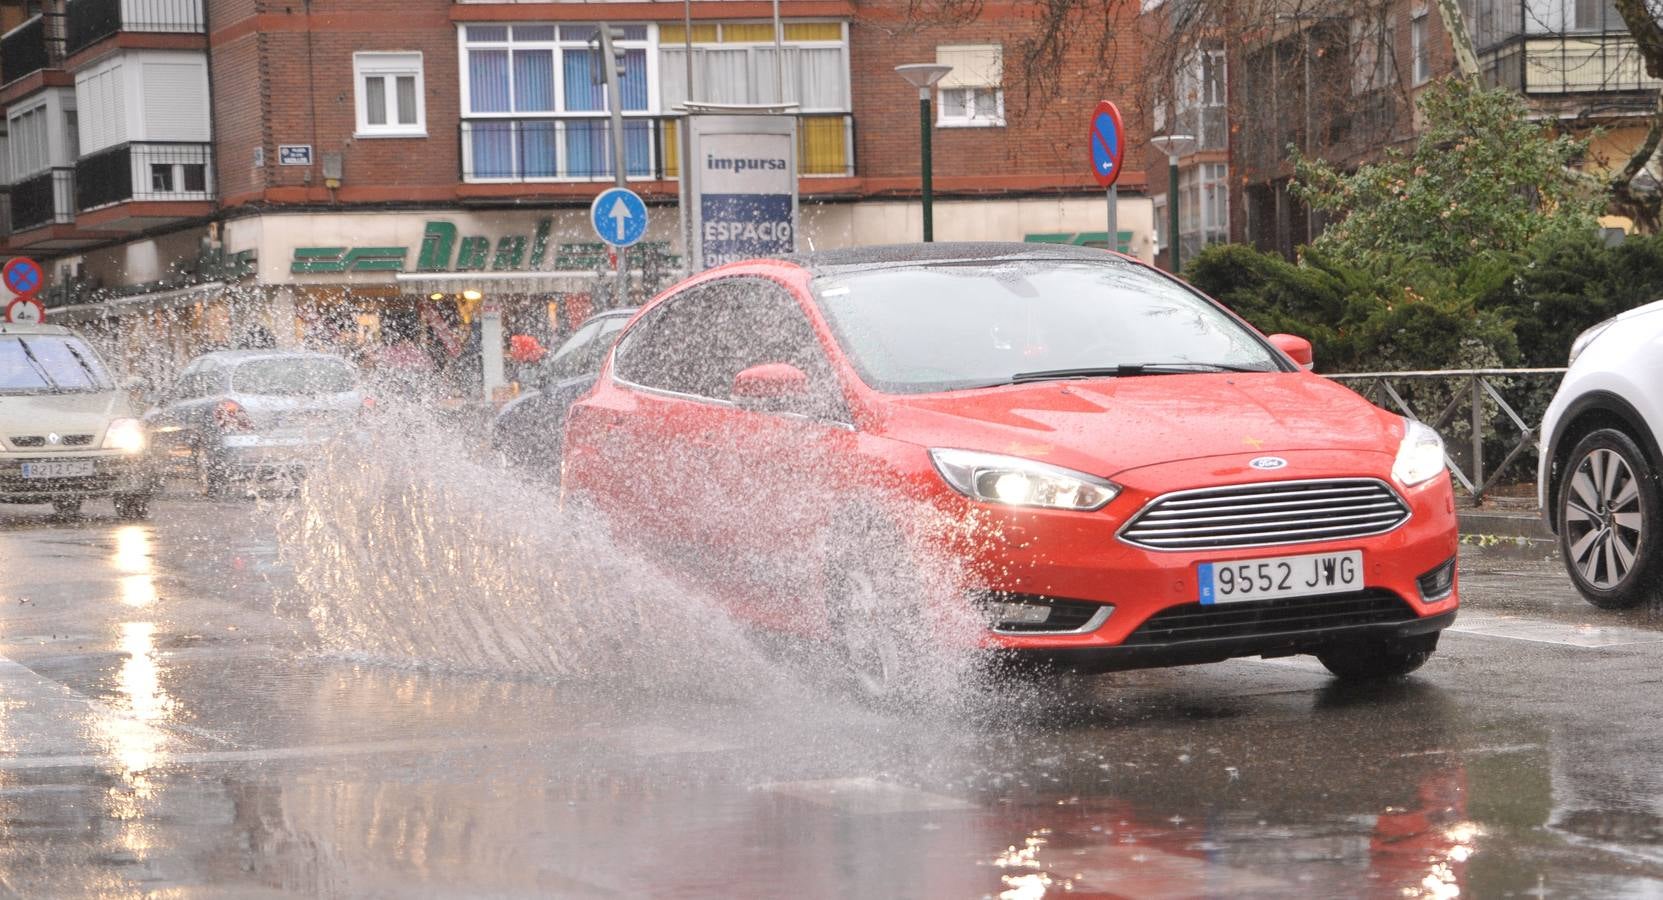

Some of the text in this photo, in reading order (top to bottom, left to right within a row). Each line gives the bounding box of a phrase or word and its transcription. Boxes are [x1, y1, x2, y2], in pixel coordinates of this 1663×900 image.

[707, 154, 786, 173] impursa
[704, 221, 791, 241] ESPACIO
[1219, 562, 1292, 595] 9552
[1305, 557, 1354, 587] JWG
